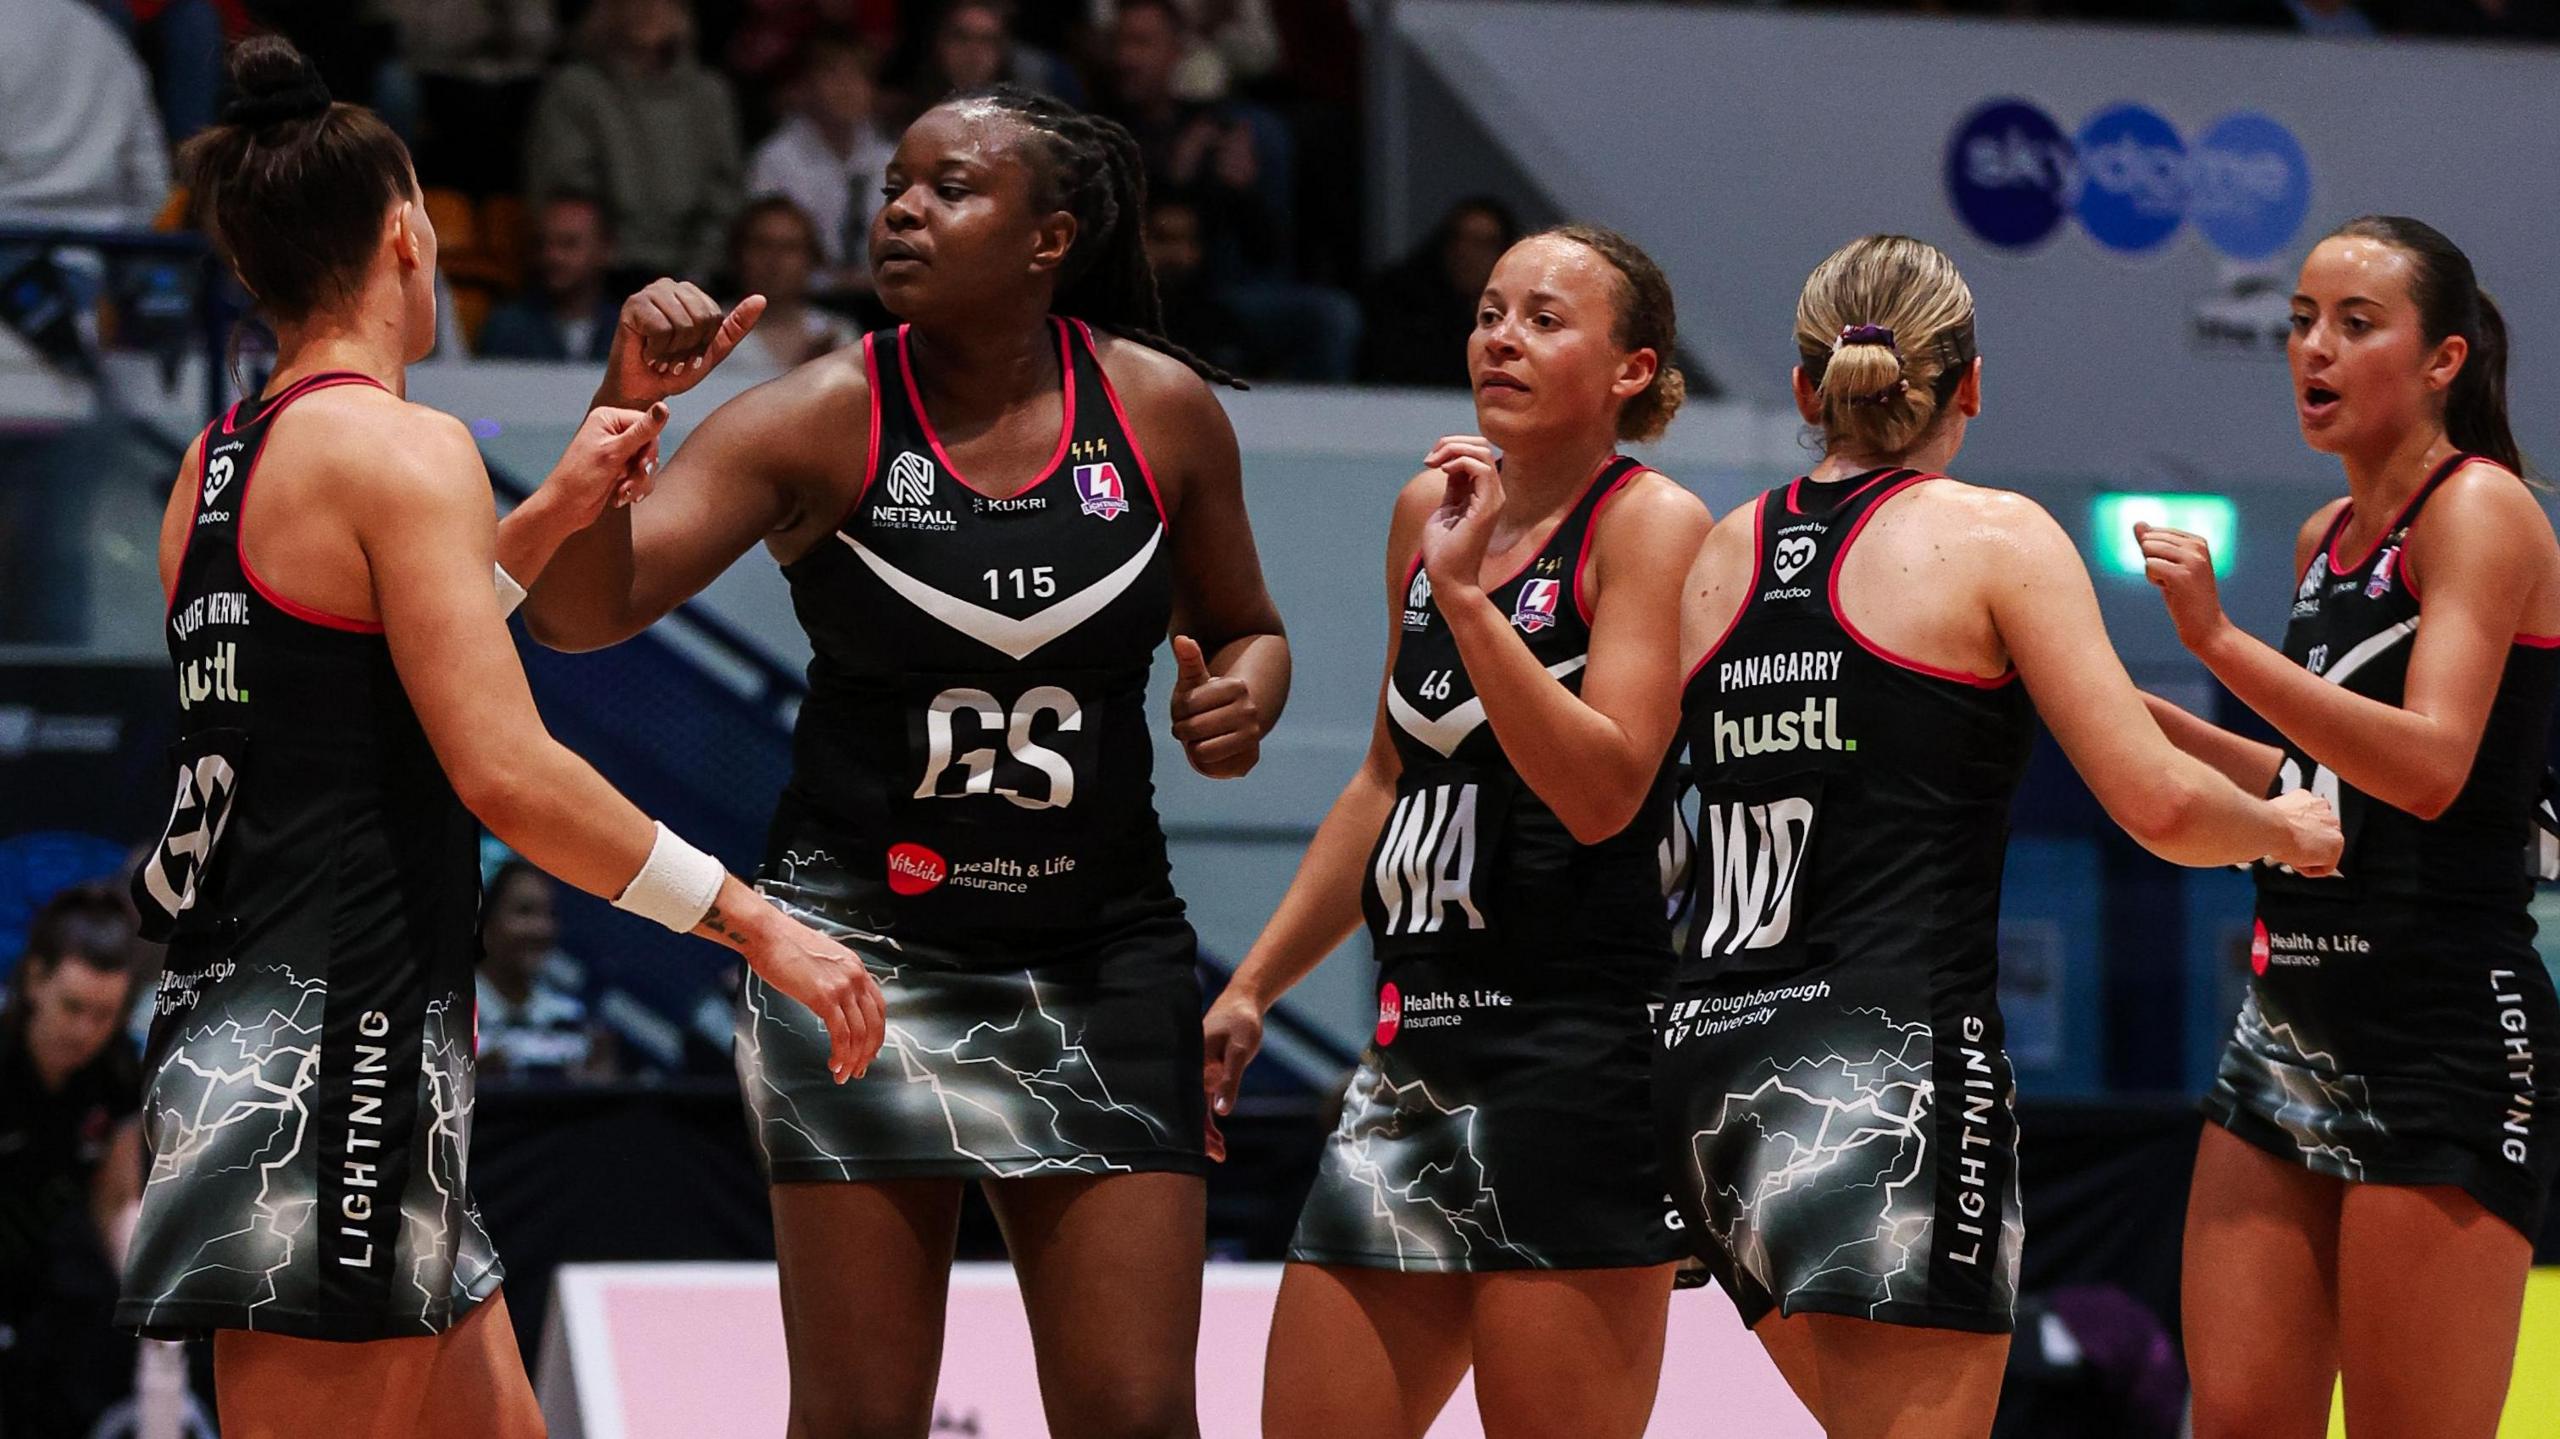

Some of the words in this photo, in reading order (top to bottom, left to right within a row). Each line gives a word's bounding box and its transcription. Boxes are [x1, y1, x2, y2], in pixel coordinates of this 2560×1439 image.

[873, 505, 958, 525] NETBALL
[988, 498, 1047, 512] KUKRI
[872, 520, 909, 530] SUPER
[912, 523, 958, 532] LEAGUE
[1815, 522, 1829, 535] by
[983, 566, 1056, 600] 115
[1419, 670, 1453, 700] 46
[1720, 651, 1843, 693] PANAGARRY
[1714, 697, 1857, 764] hustl.
[913, 685, 1083, 811] GS
[1027, 864, 1040, 878] &
[1045, 856, 1076, 876] Life
[1375, 783, 1486, 936] WA
[949, 876, 1028, 893] insurance
[1701, 797, 1814, 959] WD
[2270, 932, 2315, 951] Health
[2317, 936, 2329, 952] &
[2333, 934, 2371, 953] Life
[1404, 991, 1455, 1012] Health
[1458, 993, 1471, 1009] &
[1474, 990, 1513, 1008] Life
[1701, 980, 1831, 1014] Loughborough
[1403, 1013, 1463, 1030] insurance
[1695, 1007, 1778, 1037] University
[339, 1010, 390, 1268] LIGHTNING
[1949, 1015, 1995, 1265] LIGHTNING
